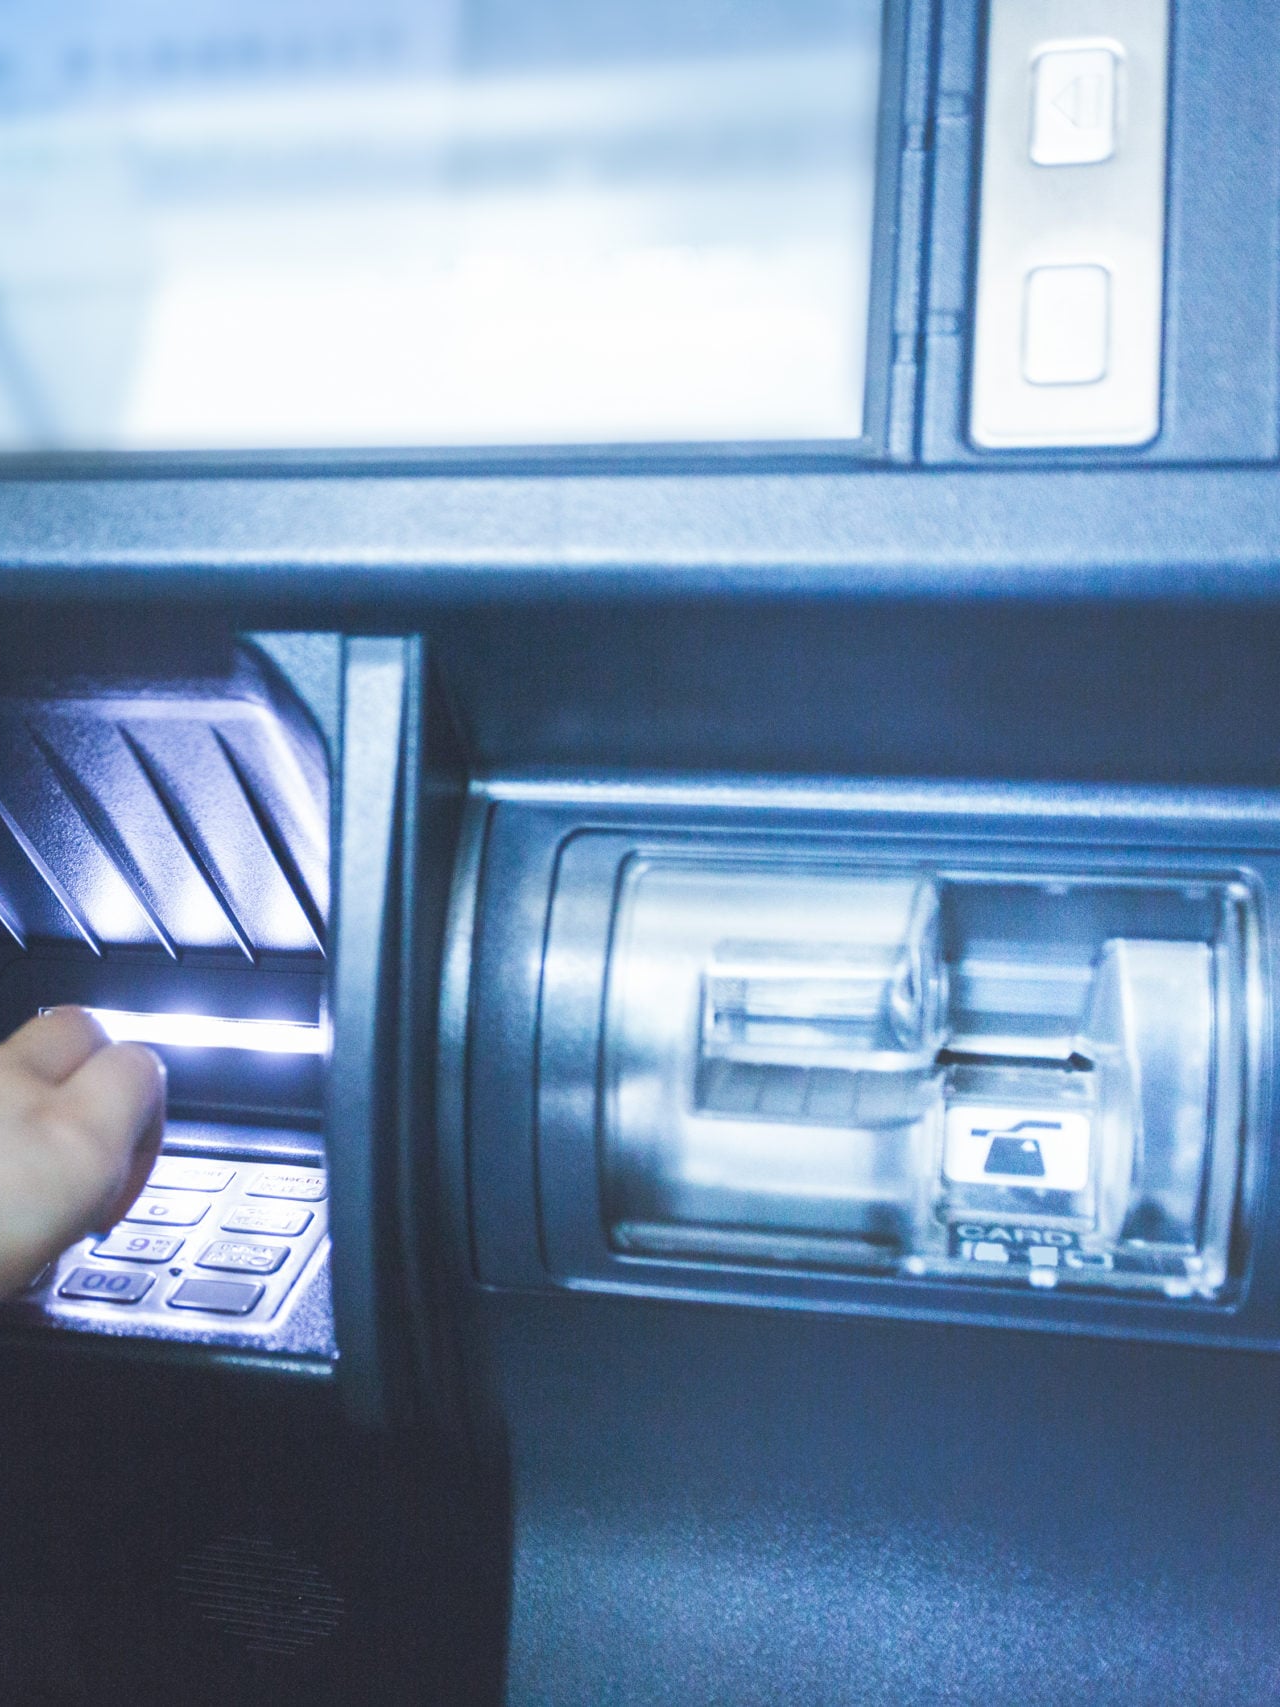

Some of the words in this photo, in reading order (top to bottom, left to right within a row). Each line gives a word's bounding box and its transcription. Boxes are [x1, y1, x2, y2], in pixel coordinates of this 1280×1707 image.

[956, 1223, 1073, 1246] CARD
[126, 1238, 150, 1251] 9
[81, 1273, 133, 1292] 00
